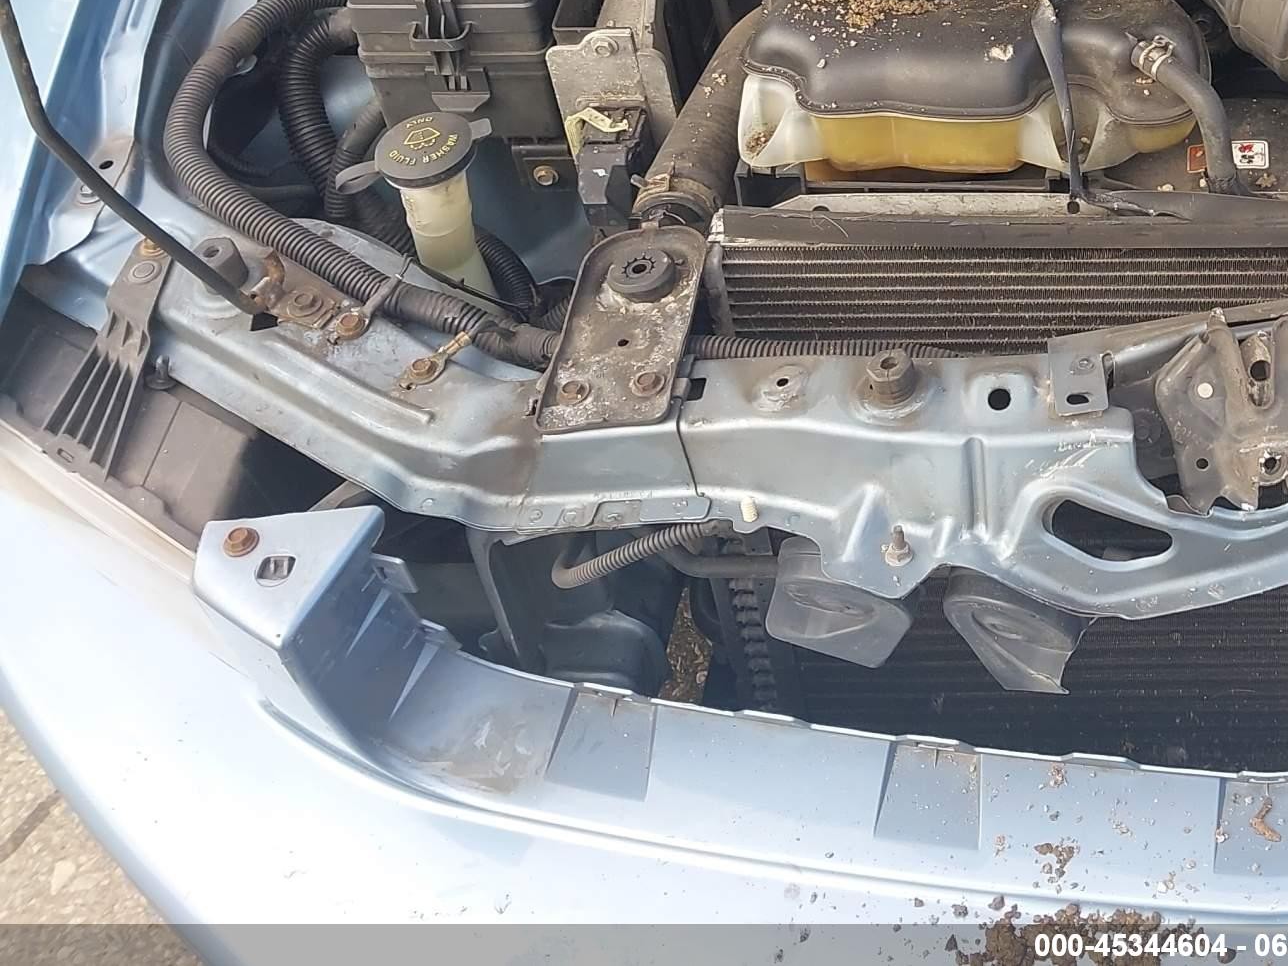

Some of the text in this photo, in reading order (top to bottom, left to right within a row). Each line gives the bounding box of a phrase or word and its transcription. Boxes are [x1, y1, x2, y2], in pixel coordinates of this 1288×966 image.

[406, 116, 433, 128] ONLY
[389, 134, 458, 166] WASHER FLUID
